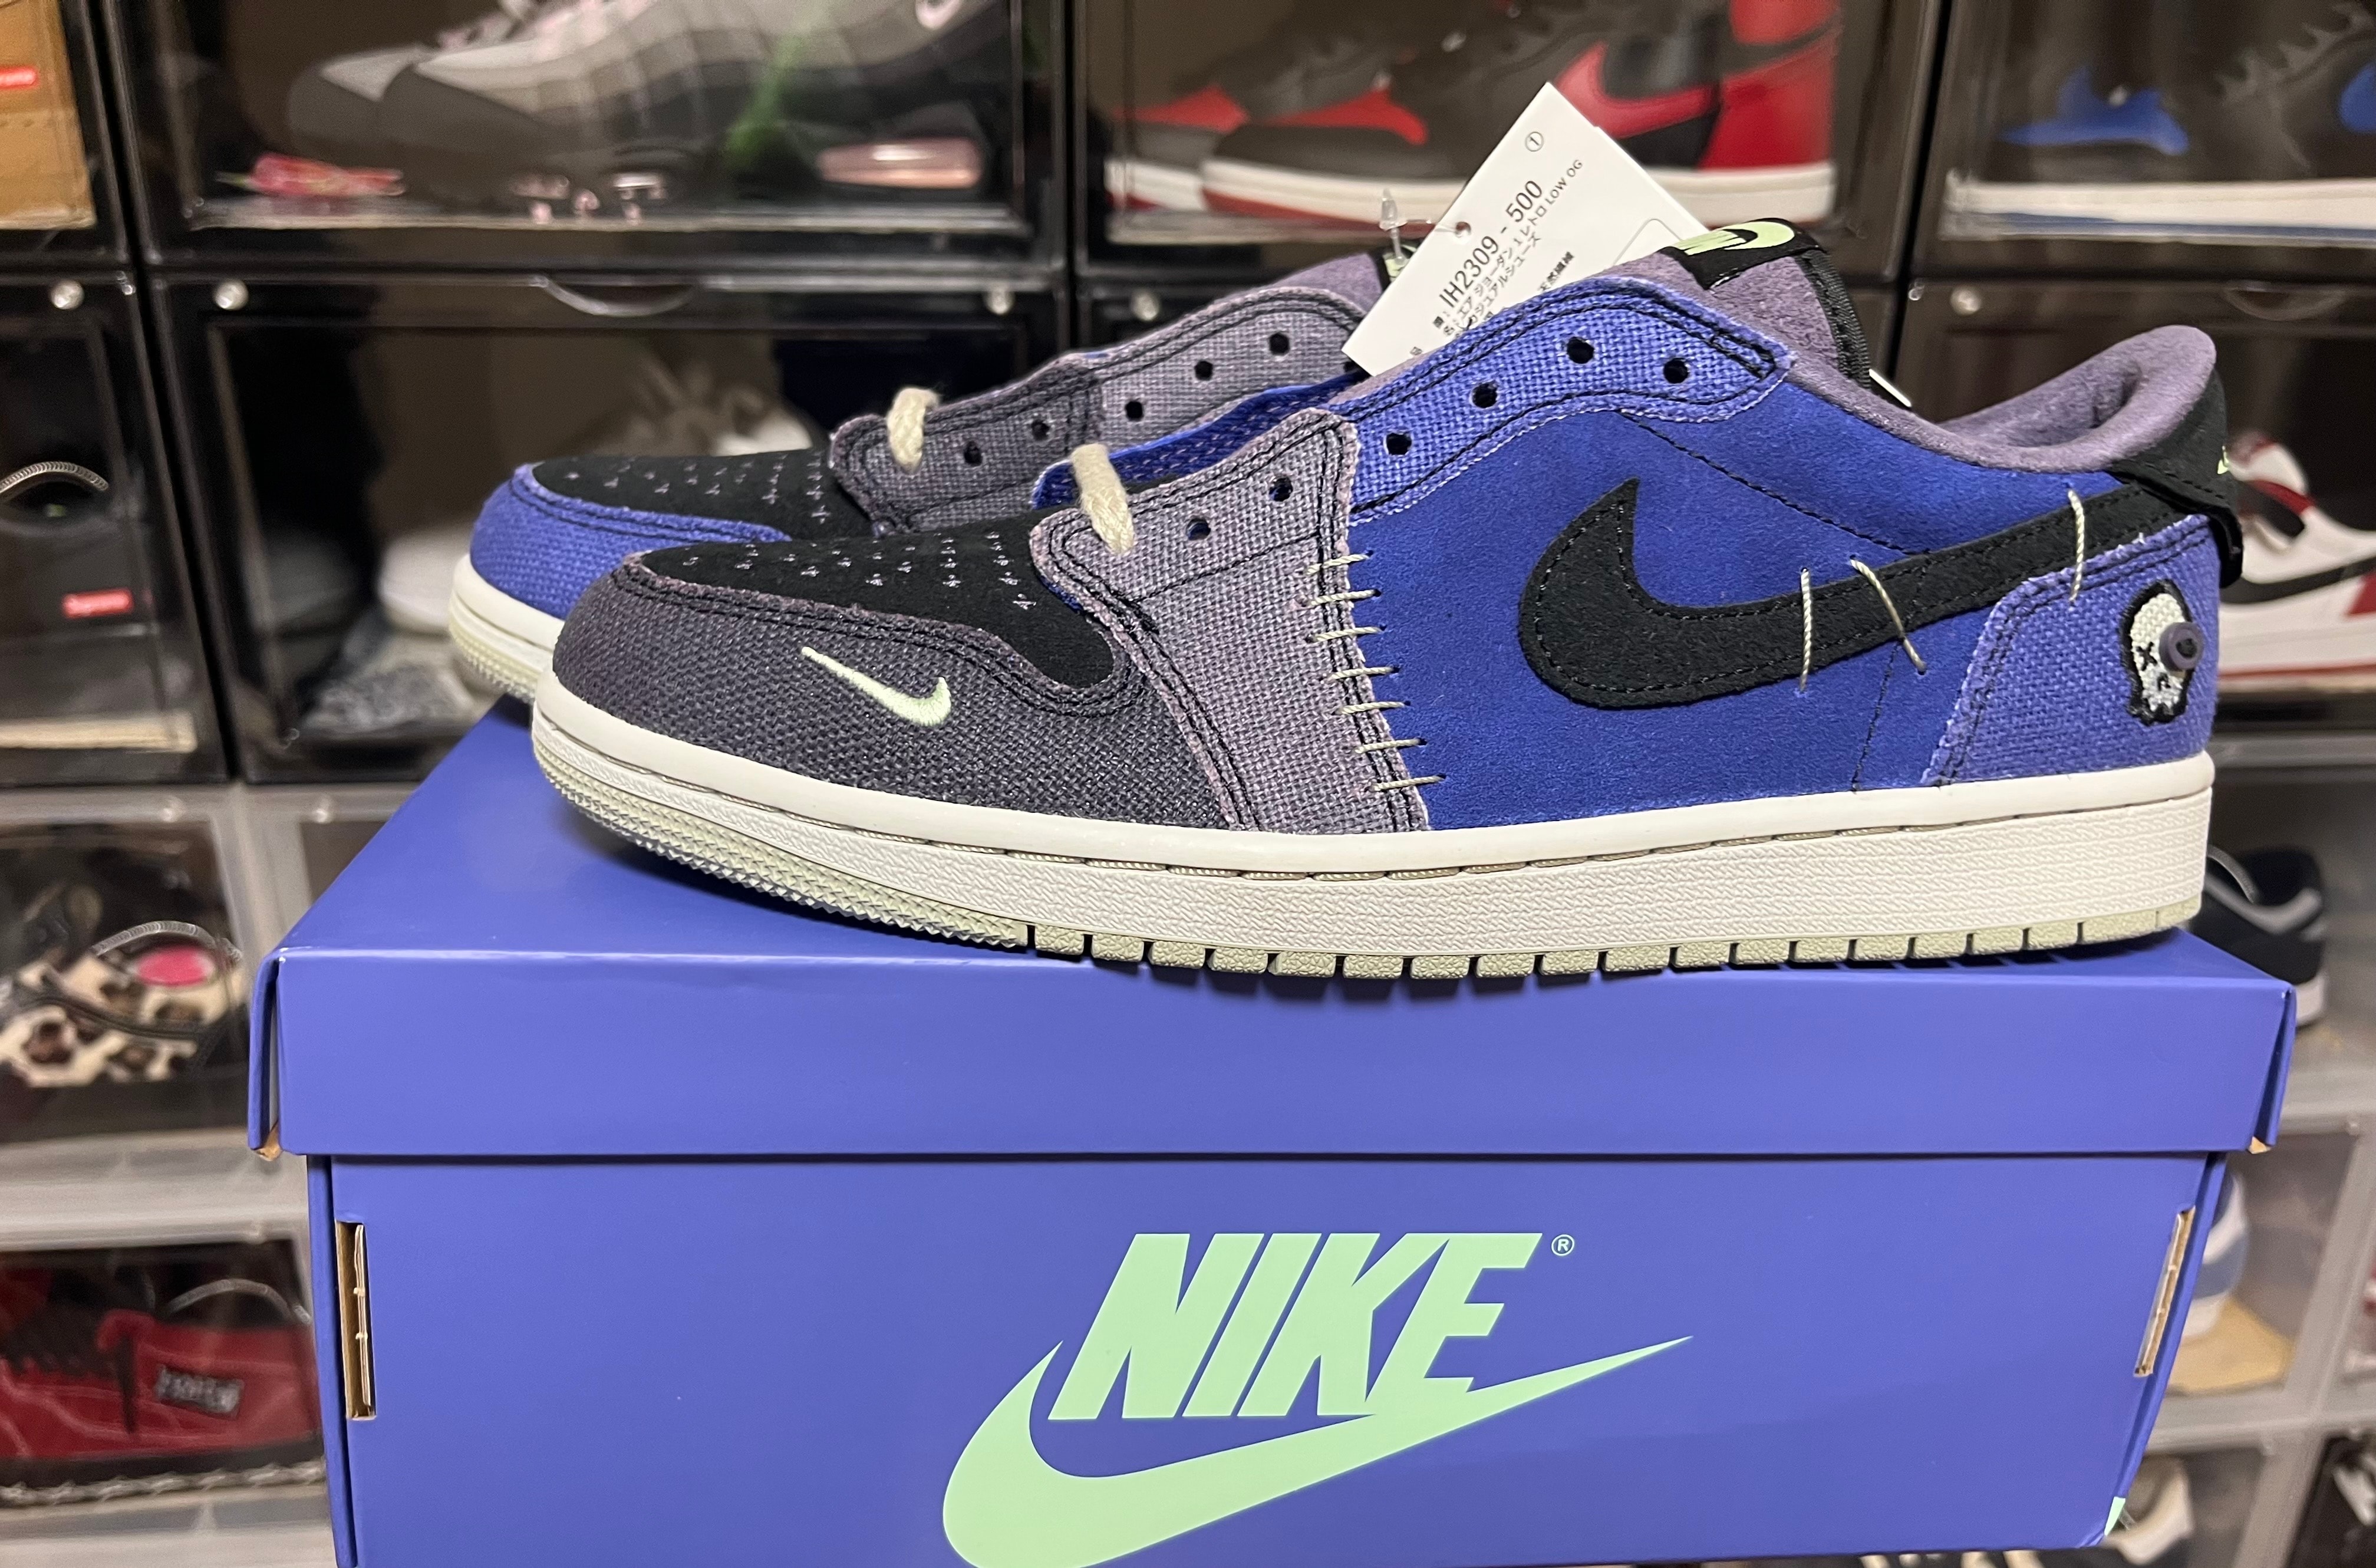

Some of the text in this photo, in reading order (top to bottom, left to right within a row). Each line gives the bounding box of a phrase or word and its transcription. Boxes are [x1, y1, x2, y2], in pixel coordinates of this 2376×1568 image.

[1439, 236, 1498, 308] IH2309
[1505, 181, 1542, 222] 500
[1520, 206, 1547, 236] レトロ
[1545, 177, 1566, 205] LOW
[1567, 160, 1582, 177] OG
[1047, 1233, 1542, 1419] NIKE
